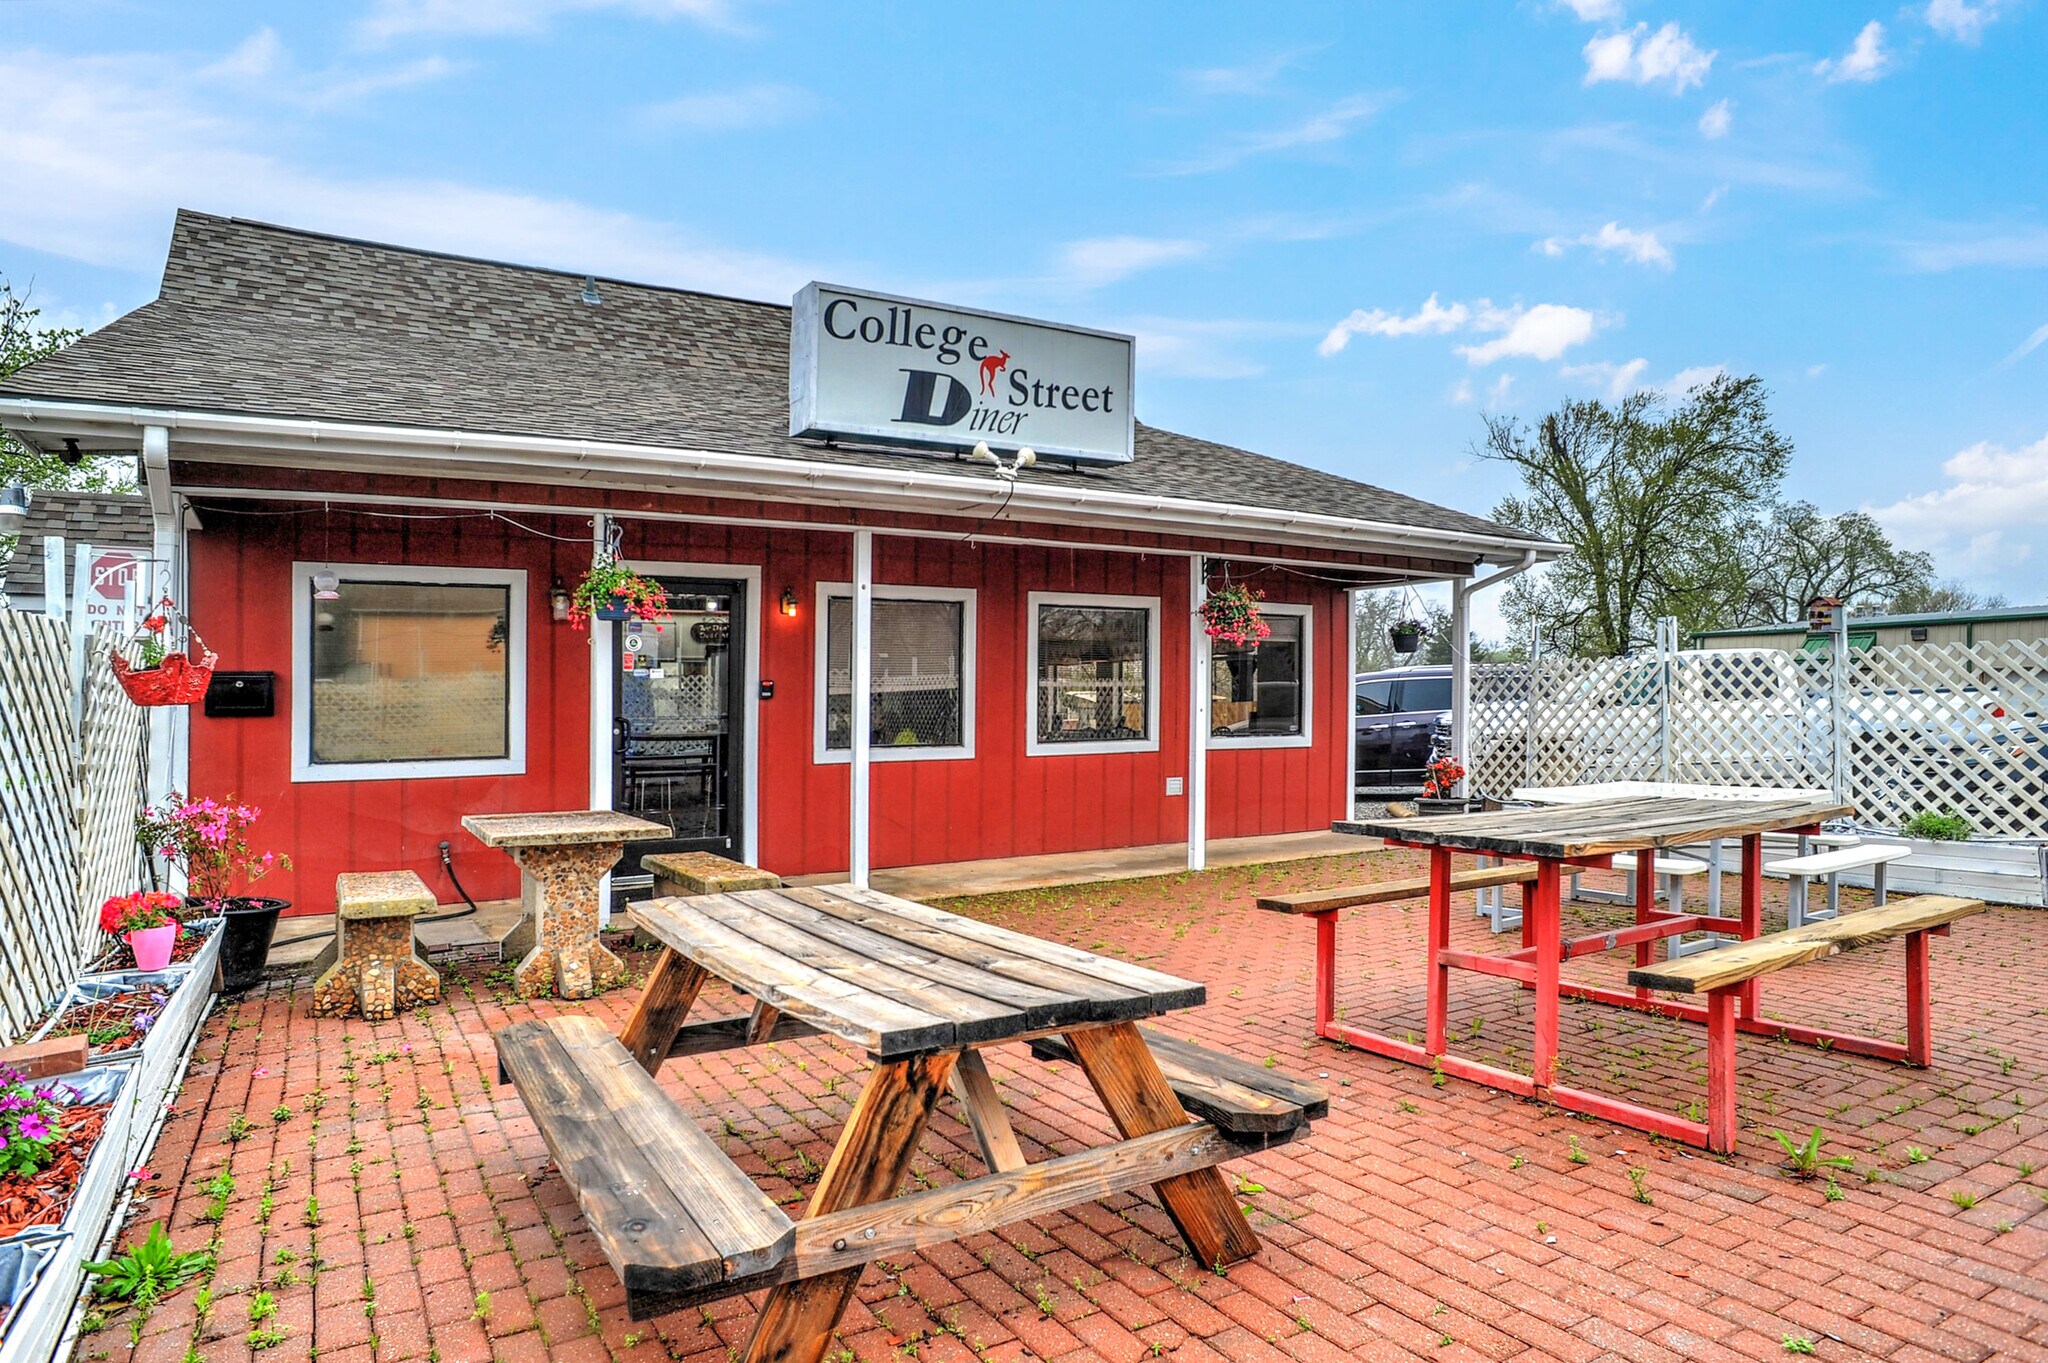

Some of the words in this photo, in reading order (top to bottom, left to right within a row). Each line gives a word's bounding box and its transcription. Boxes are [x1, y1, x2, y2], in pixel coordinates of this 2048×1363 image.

[824, 299, 988, 365] College
[891, 368, 1029, 435] Diner
[1008, 368, 1113, 413] Street
[87, 604, 107, 615] DO
[116, 605, 146, 616] NT
